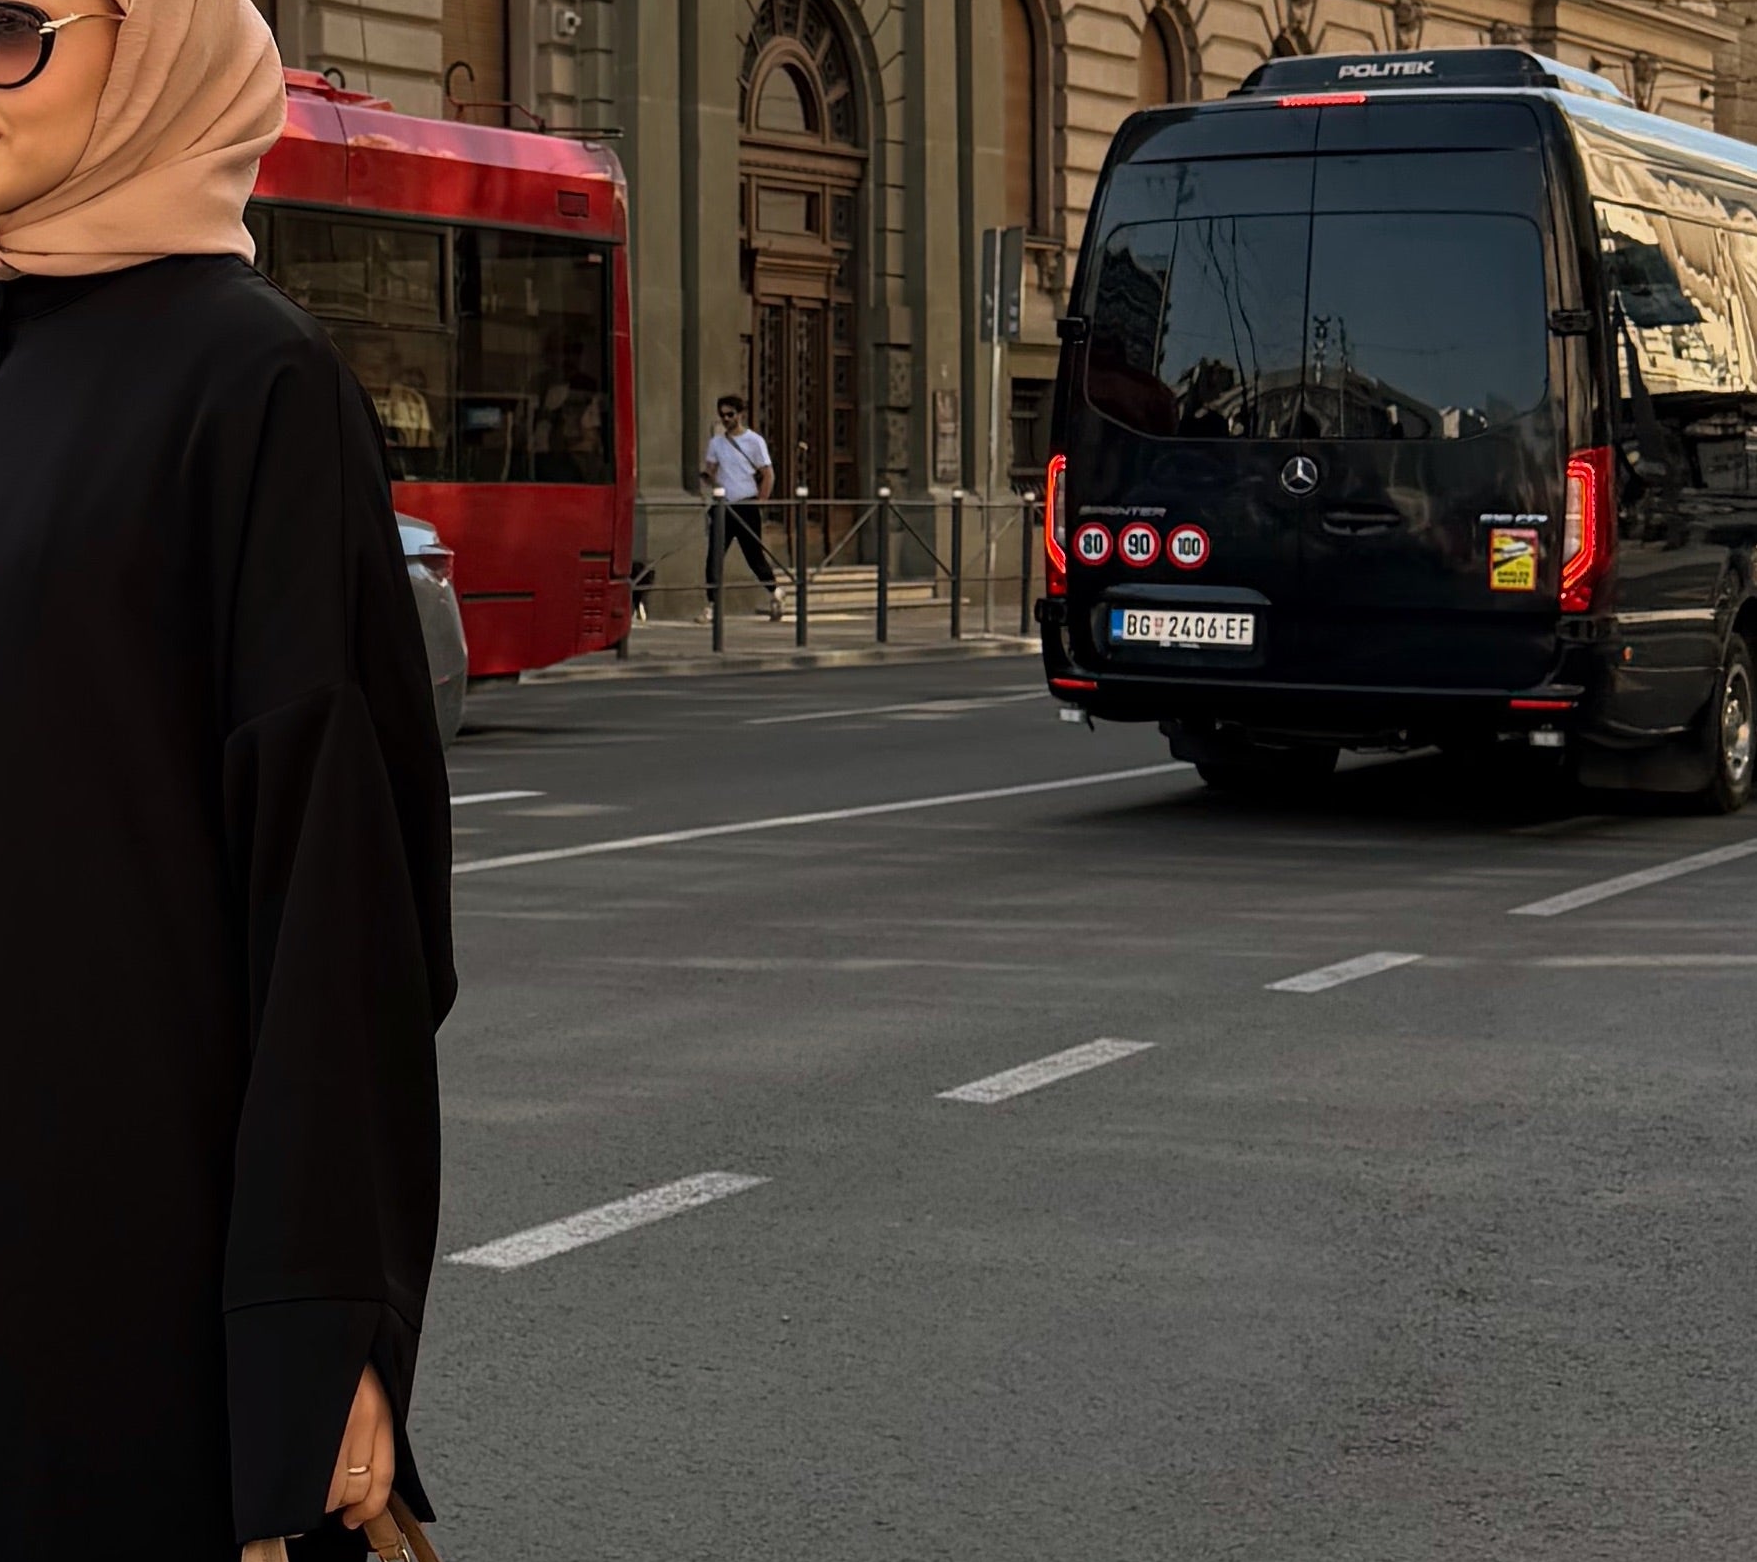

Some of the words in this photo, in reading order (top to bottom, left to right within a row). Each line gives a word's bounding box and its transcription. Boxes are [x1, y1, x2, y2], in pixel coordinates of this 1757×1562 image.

[1338, 60, 1434, 79] POLITEK
[1082, 533, 1104, 555] 80
[1128, 533, 1151, 556] 90
[1177, 537, 1201, 556] 100
[1126, 614, 1151, 636] BG
